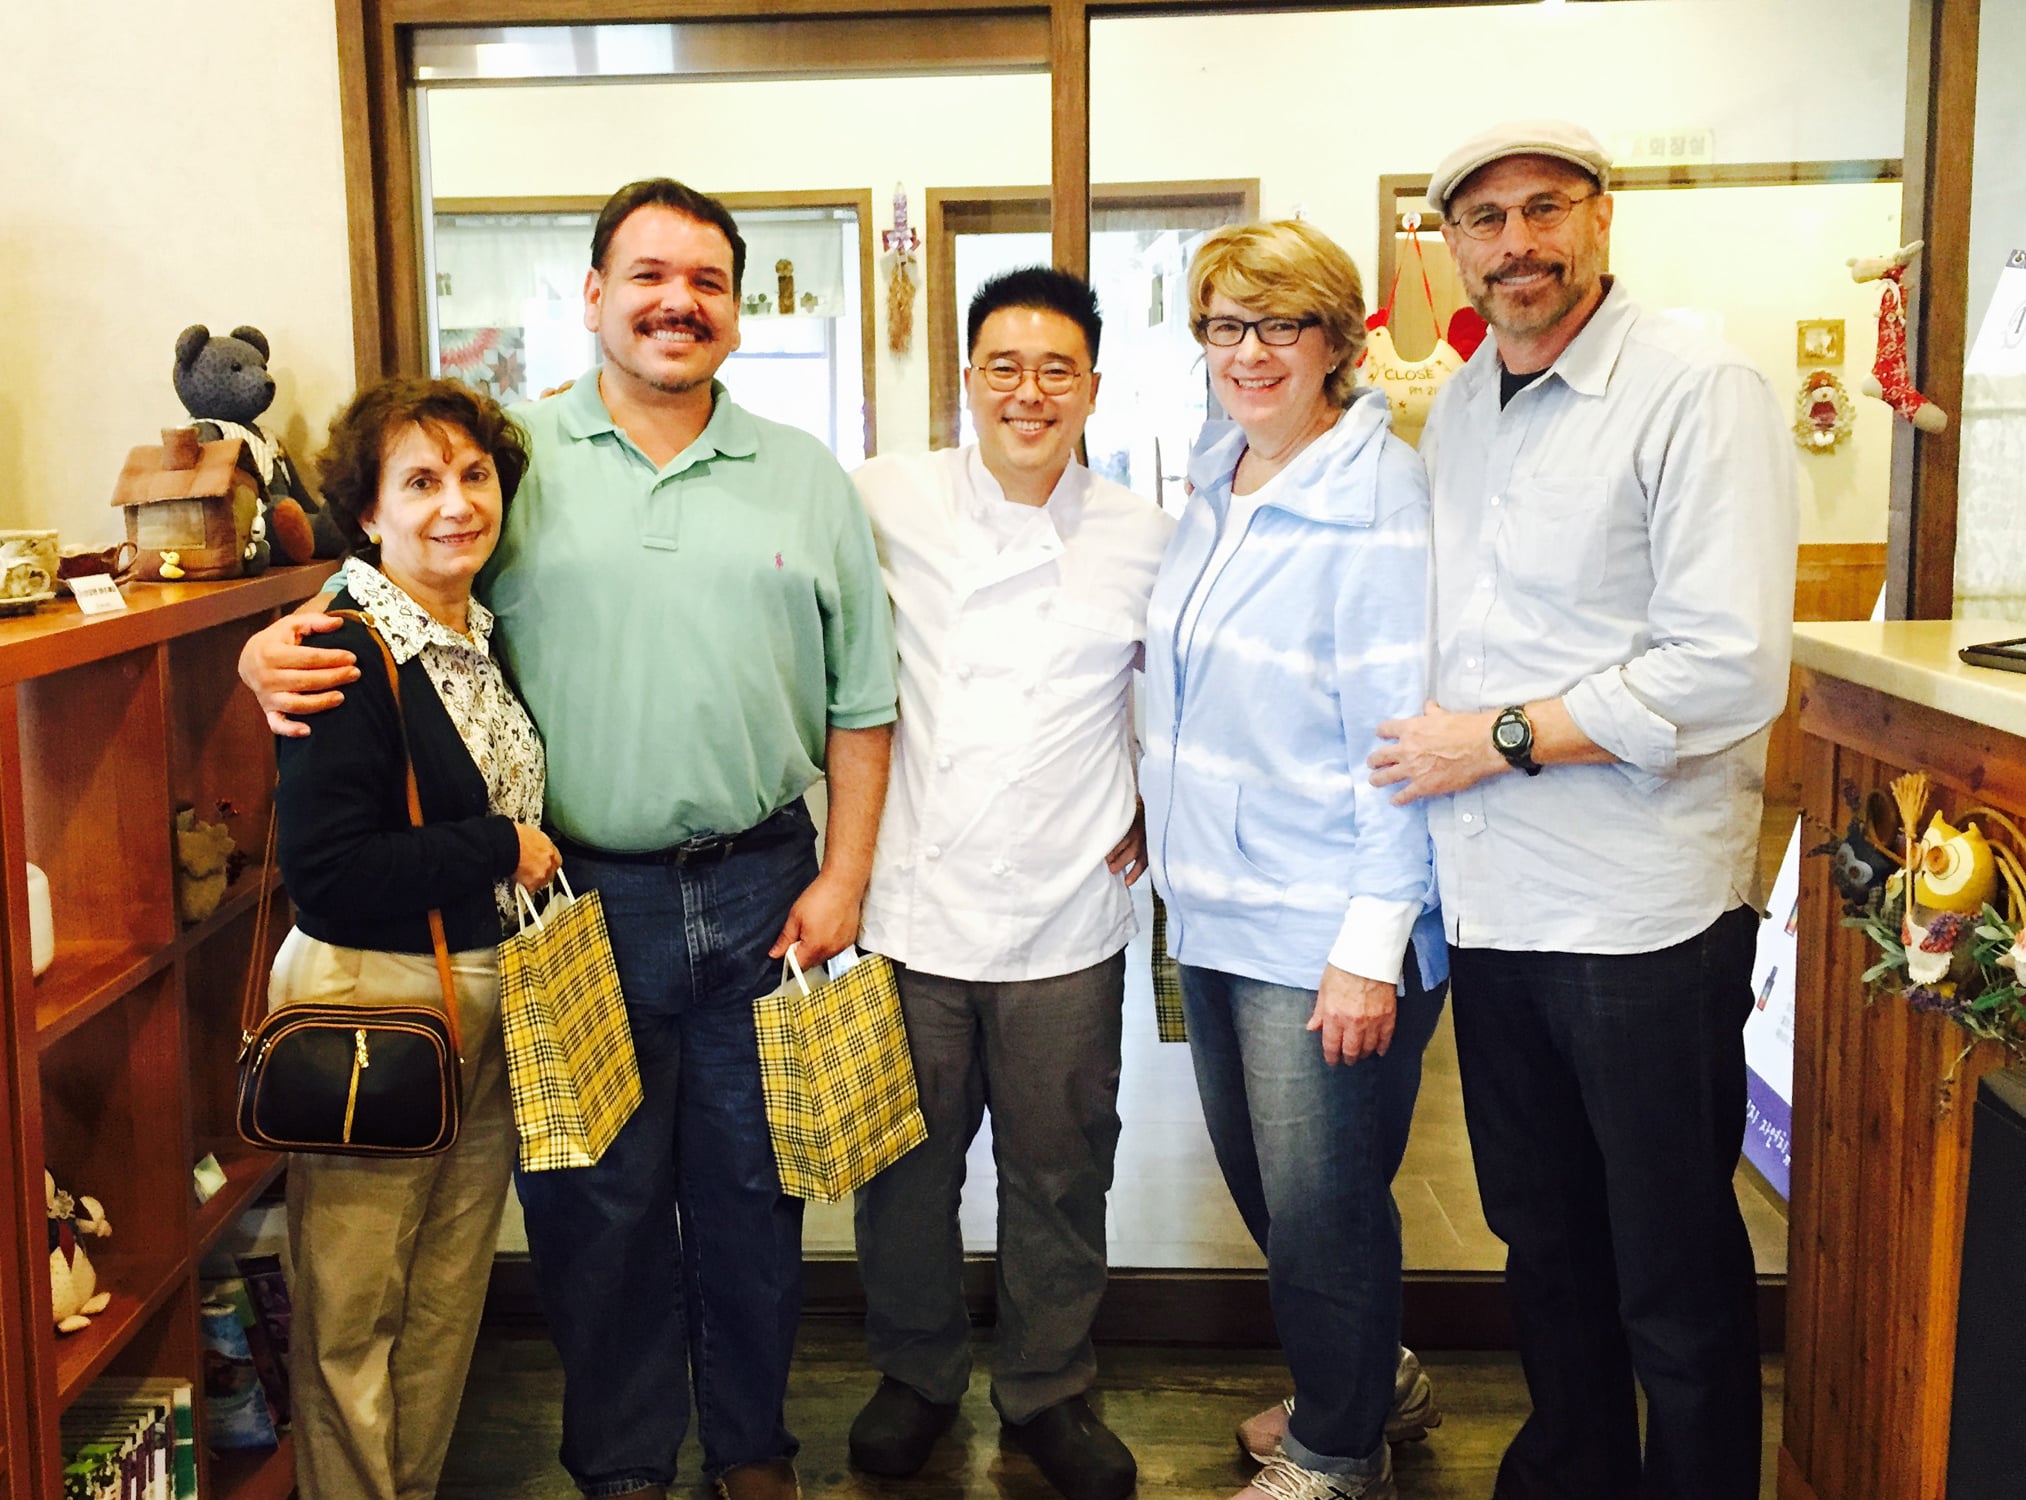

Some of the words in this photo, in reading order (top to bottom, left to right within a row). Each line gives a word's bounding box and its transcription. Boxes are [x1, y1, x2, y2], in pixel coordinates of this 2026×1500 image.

[1649, 136, 1705, 156] 화장실
[1384, 368, 1436, 381] CLOSE
[1408, 386, 1423, 396] PM
